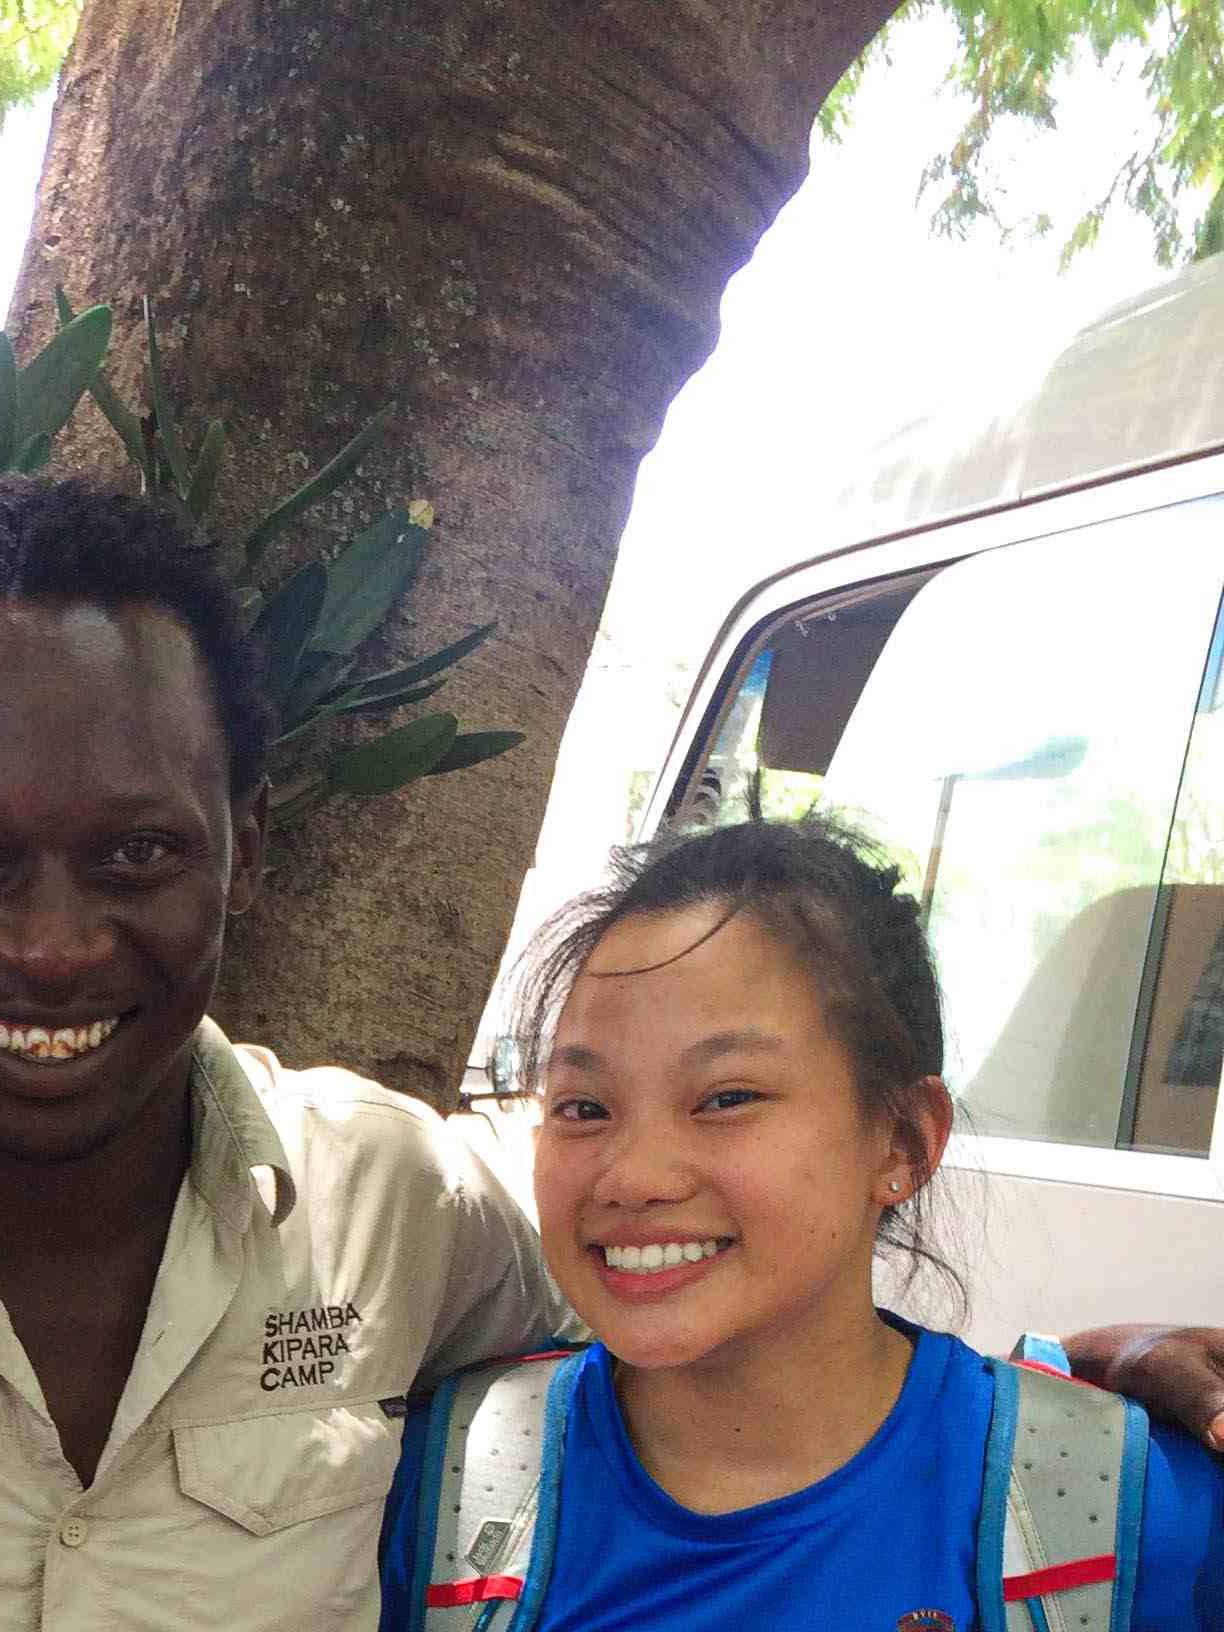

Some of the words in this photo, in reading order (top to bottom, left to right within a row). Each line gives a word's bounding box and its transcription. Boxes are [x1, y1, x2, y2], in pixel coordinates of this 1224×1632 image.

[264, 1303, 363, 1337] SHAMBA
[262, 1333, 351, 1365] KIPARA
[260, 1361, 335, 1392] CAMP
